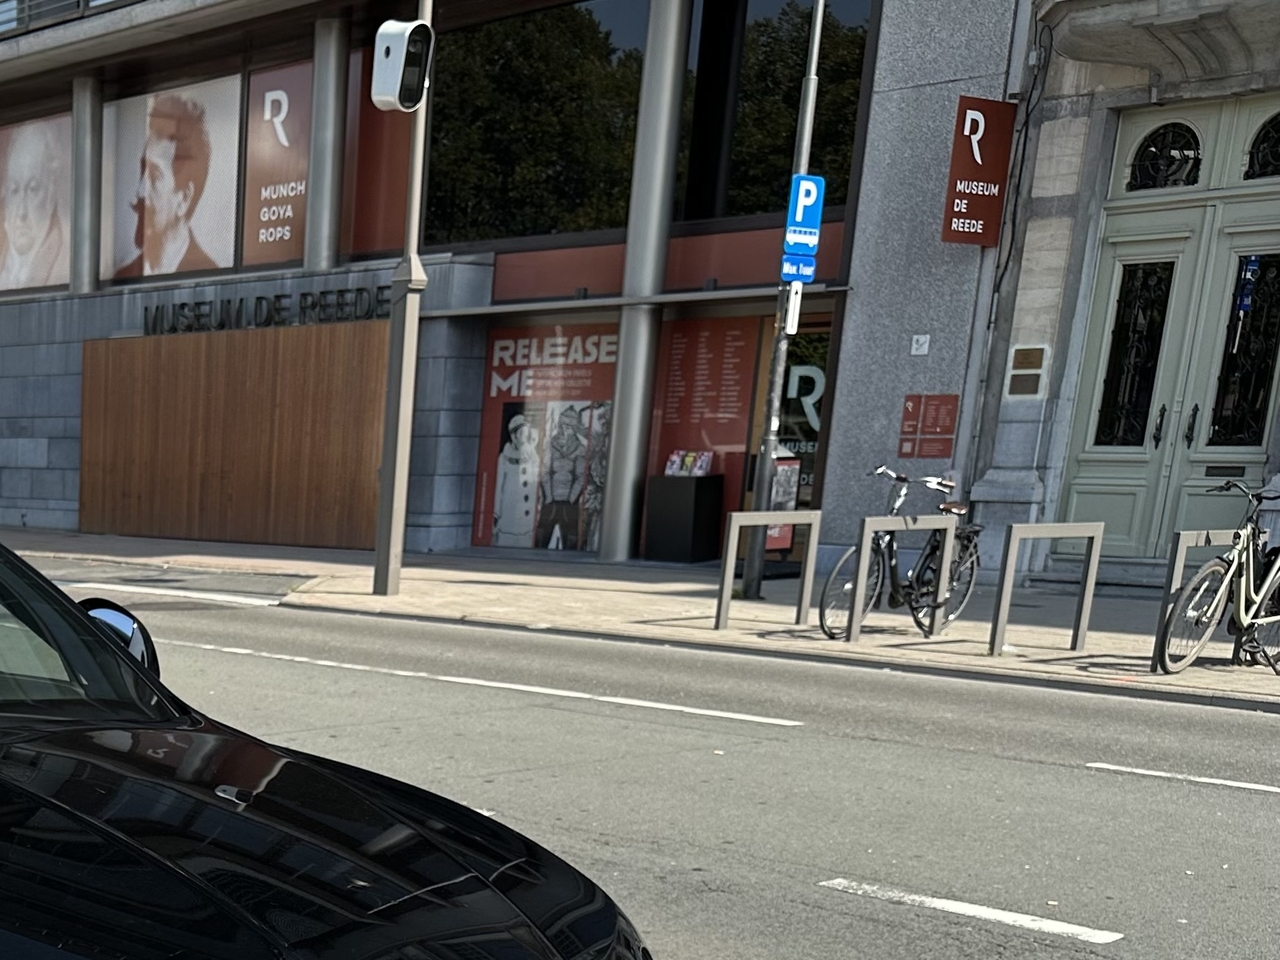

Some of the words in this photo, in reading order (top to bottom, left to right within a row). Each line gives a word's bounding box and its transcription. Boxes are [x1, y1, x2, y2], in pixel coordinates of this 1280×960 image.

[964, 109, 985, 165] R
[261, 181, 306, 200] MUNCH
[956, 180, 999, 196] MUSEUM
[795, 180, 818, 222] P
[954, 199, 968, 212] DE
[260, 204, 293, 221] GOYA
[259, 226, 291, 243] ROPS
[951, 218, 984, 233] REEDE
[144, 299, 243, 335] MUSEUM
[255, 295, 291, 326] DE
[299, 286, 392, 324] REEDE
[492, 335, 618, 366] RELEASE
[490, 368, 533, 397] ME
